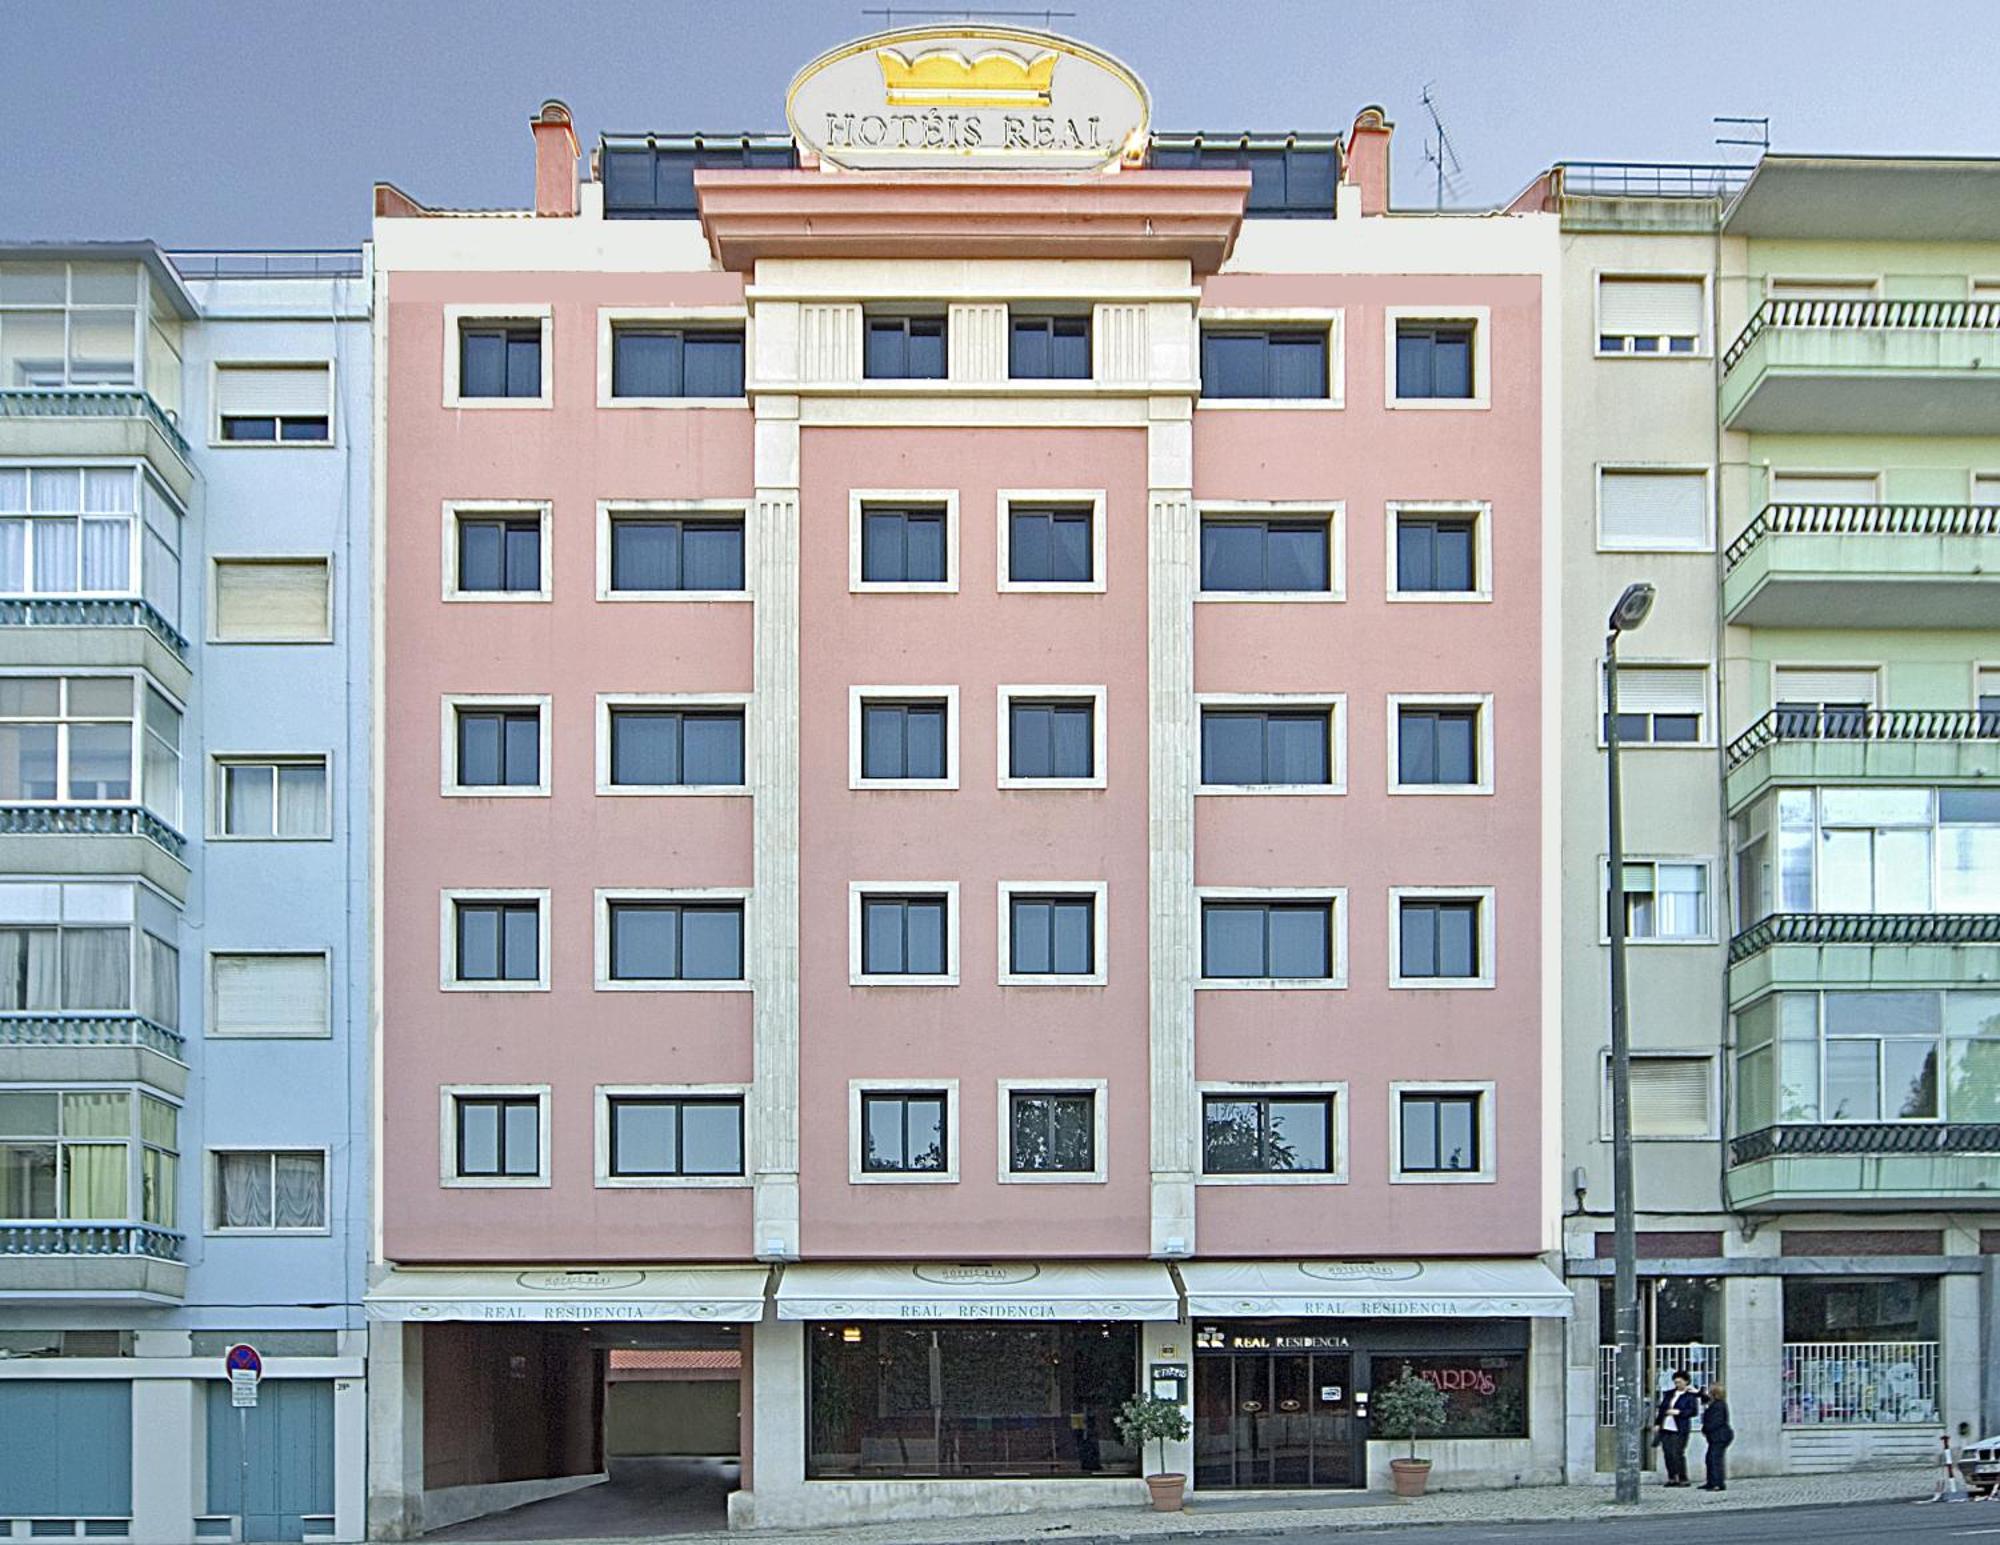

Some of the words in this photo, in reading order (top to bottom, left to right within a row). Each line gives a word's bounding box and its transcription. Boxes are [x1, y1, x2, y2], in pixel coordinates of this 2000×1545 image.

[825, 108, 983, 150] HOTÉIS
[1003, 116, 1111, 150] REAL
[484, 1306, 526, 1319] REAL
[544, 1306, 644, 1319] RESIDENCIA
[901, 1305, 943, 1318] REAL
[958, 1305, 1057, 1318] RESIDENCIA
[1305, 1301, 1346, 1315] REAL
[1361, 1301, 1459, 1315] RESIDENCIA
[1234, 1337, 1270, 1348] REAL
[1276, 1337, 1350, 1348] RESIDENCIA
